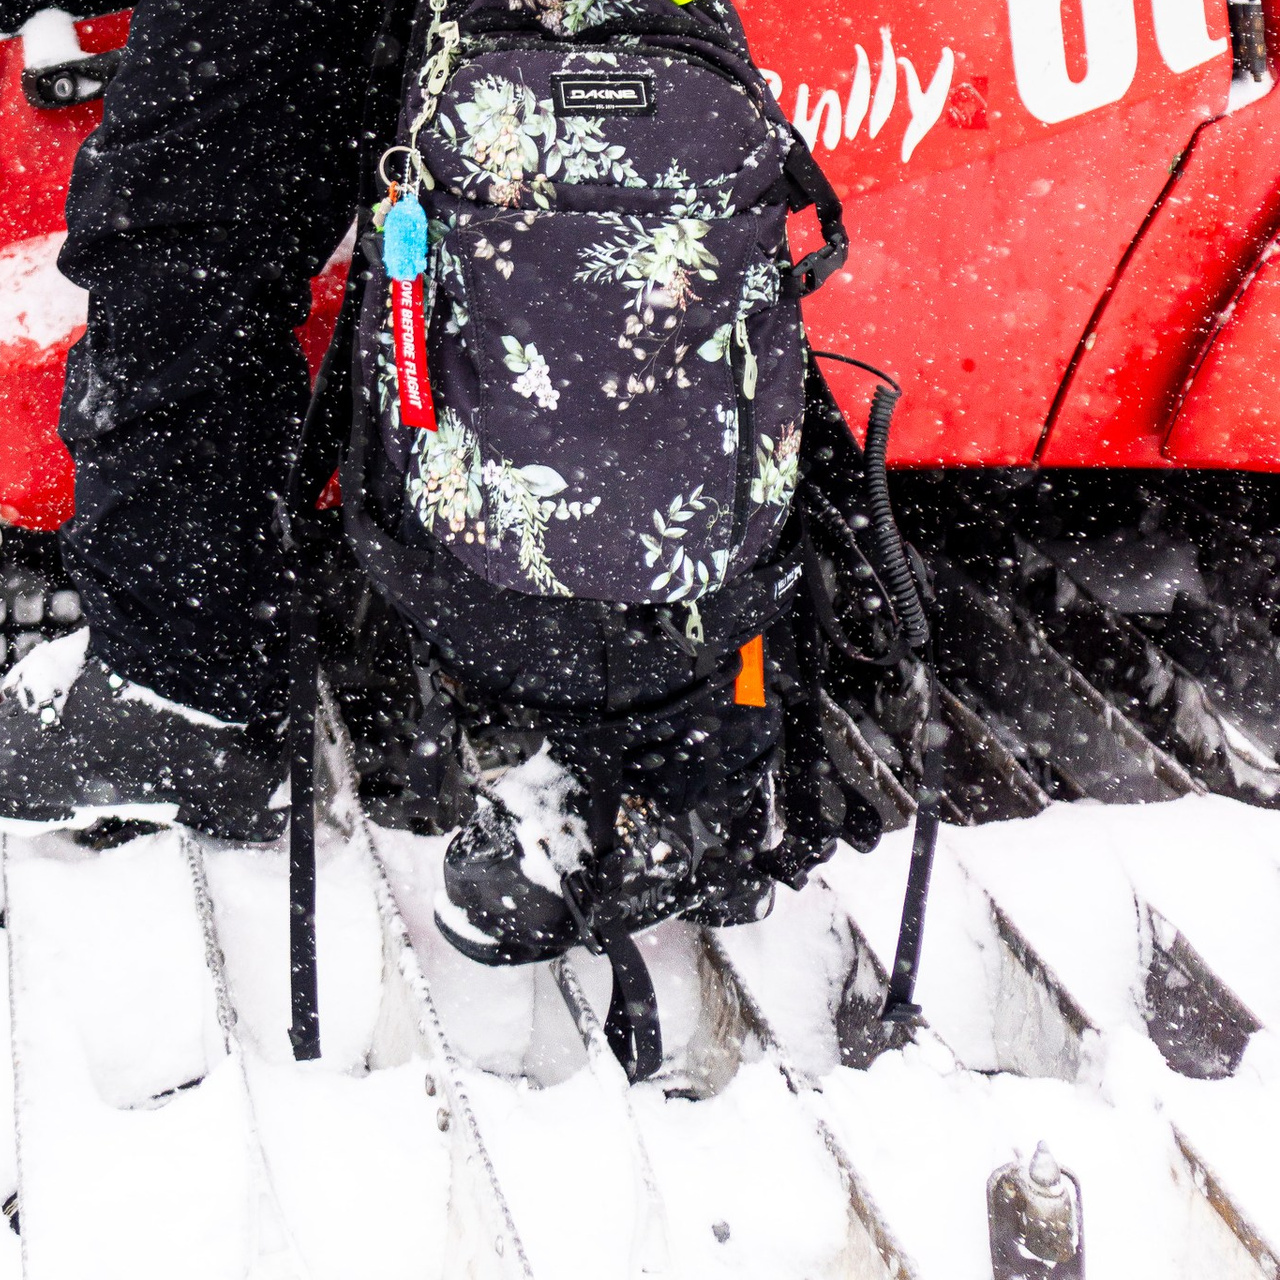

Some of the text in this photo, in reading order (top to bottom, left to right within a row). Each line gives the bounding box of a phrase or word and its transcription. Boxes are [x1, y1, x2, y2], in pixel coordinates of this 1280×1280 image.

[570, 89, 638, 100] DAKINE
[759, 25, 955, 164] ully
[401, 308, 416, 360] BEFORE
[404, 360, 423, 410] FLIGHT
